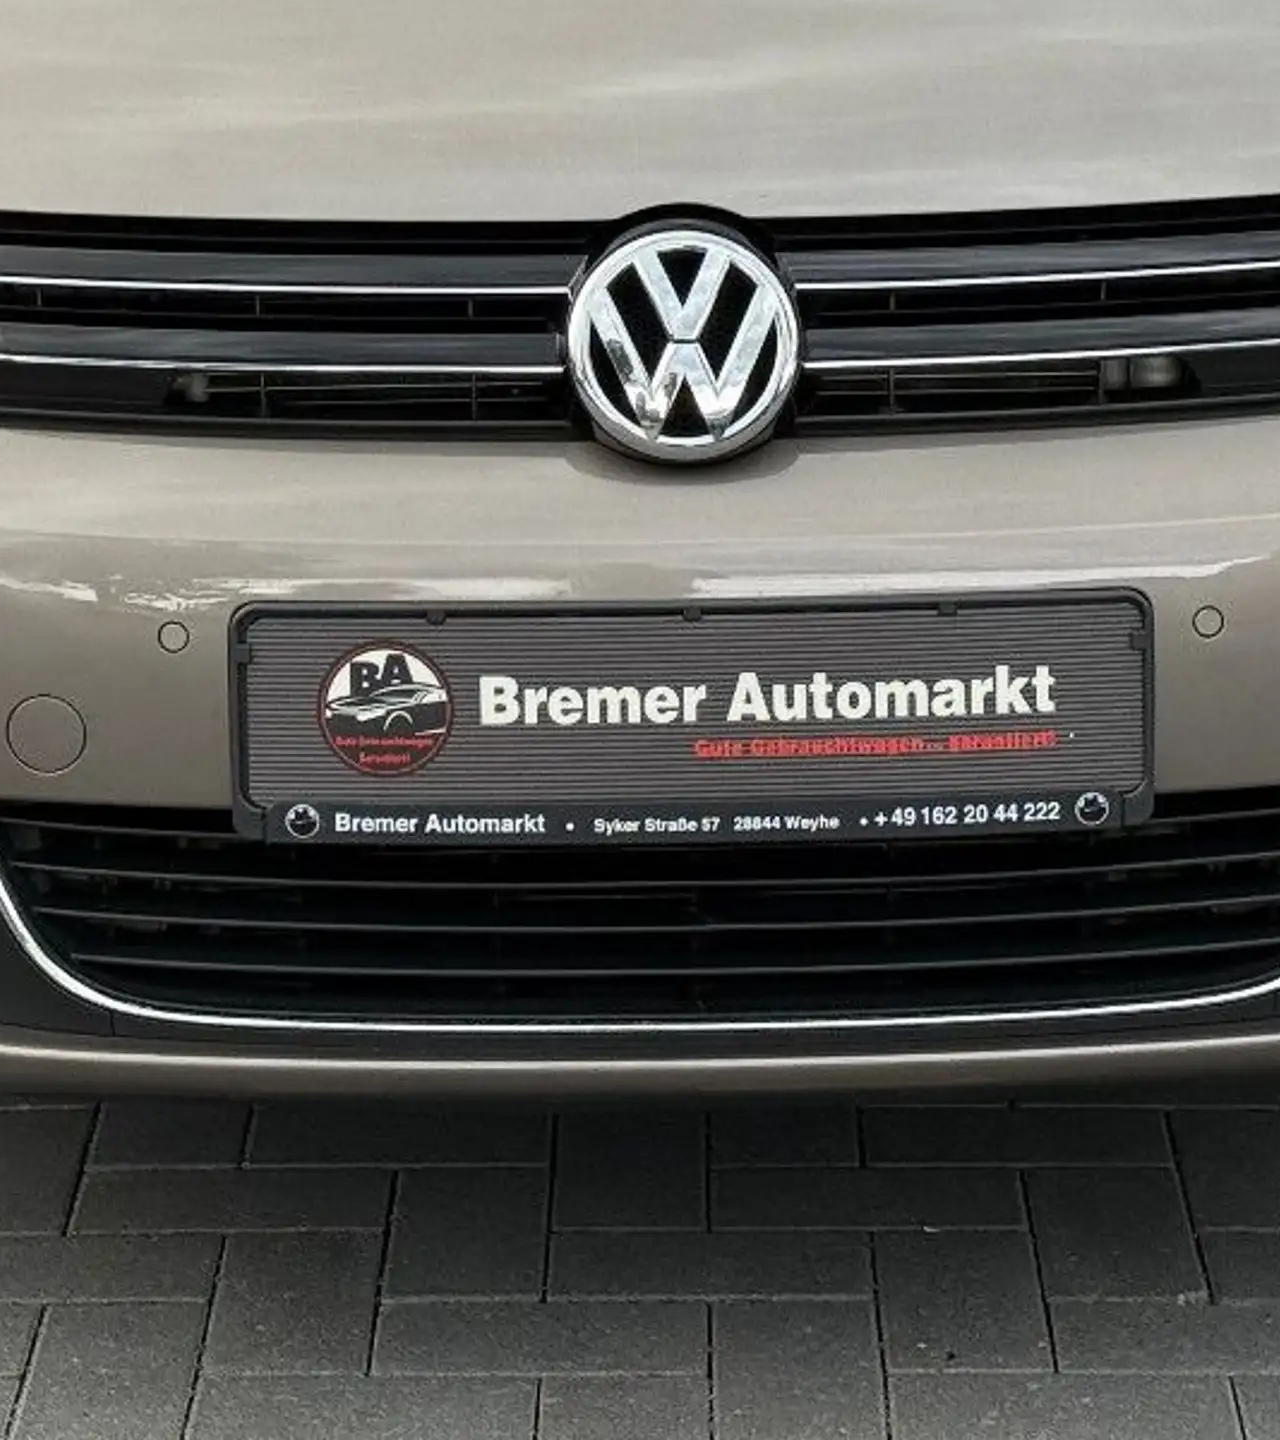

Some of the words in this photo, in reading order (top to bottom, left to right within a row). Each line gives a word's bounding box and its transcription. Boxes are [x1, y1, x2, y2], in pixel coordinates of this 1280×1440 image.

[582, 240, 782, 446] VW
[350, 653, 414, 698] BA
[478, 674, 708, 726] Bremer
[726, 664, 1056, 722] Automarkt
[334, 812, 418, 833] Bremer
[424, 812, 546, 834] Automarkt
[785, 814, 841, 832] Weyhe
[920, 805, 959, 826] 162
[963, 804, 989, 824] 20
[993, 803, 1019, 823] 44
[1023, 801, 1061, 822] 222
[593, 818, 640, 836] Syker
[644, 817, 699, 832] Straße
